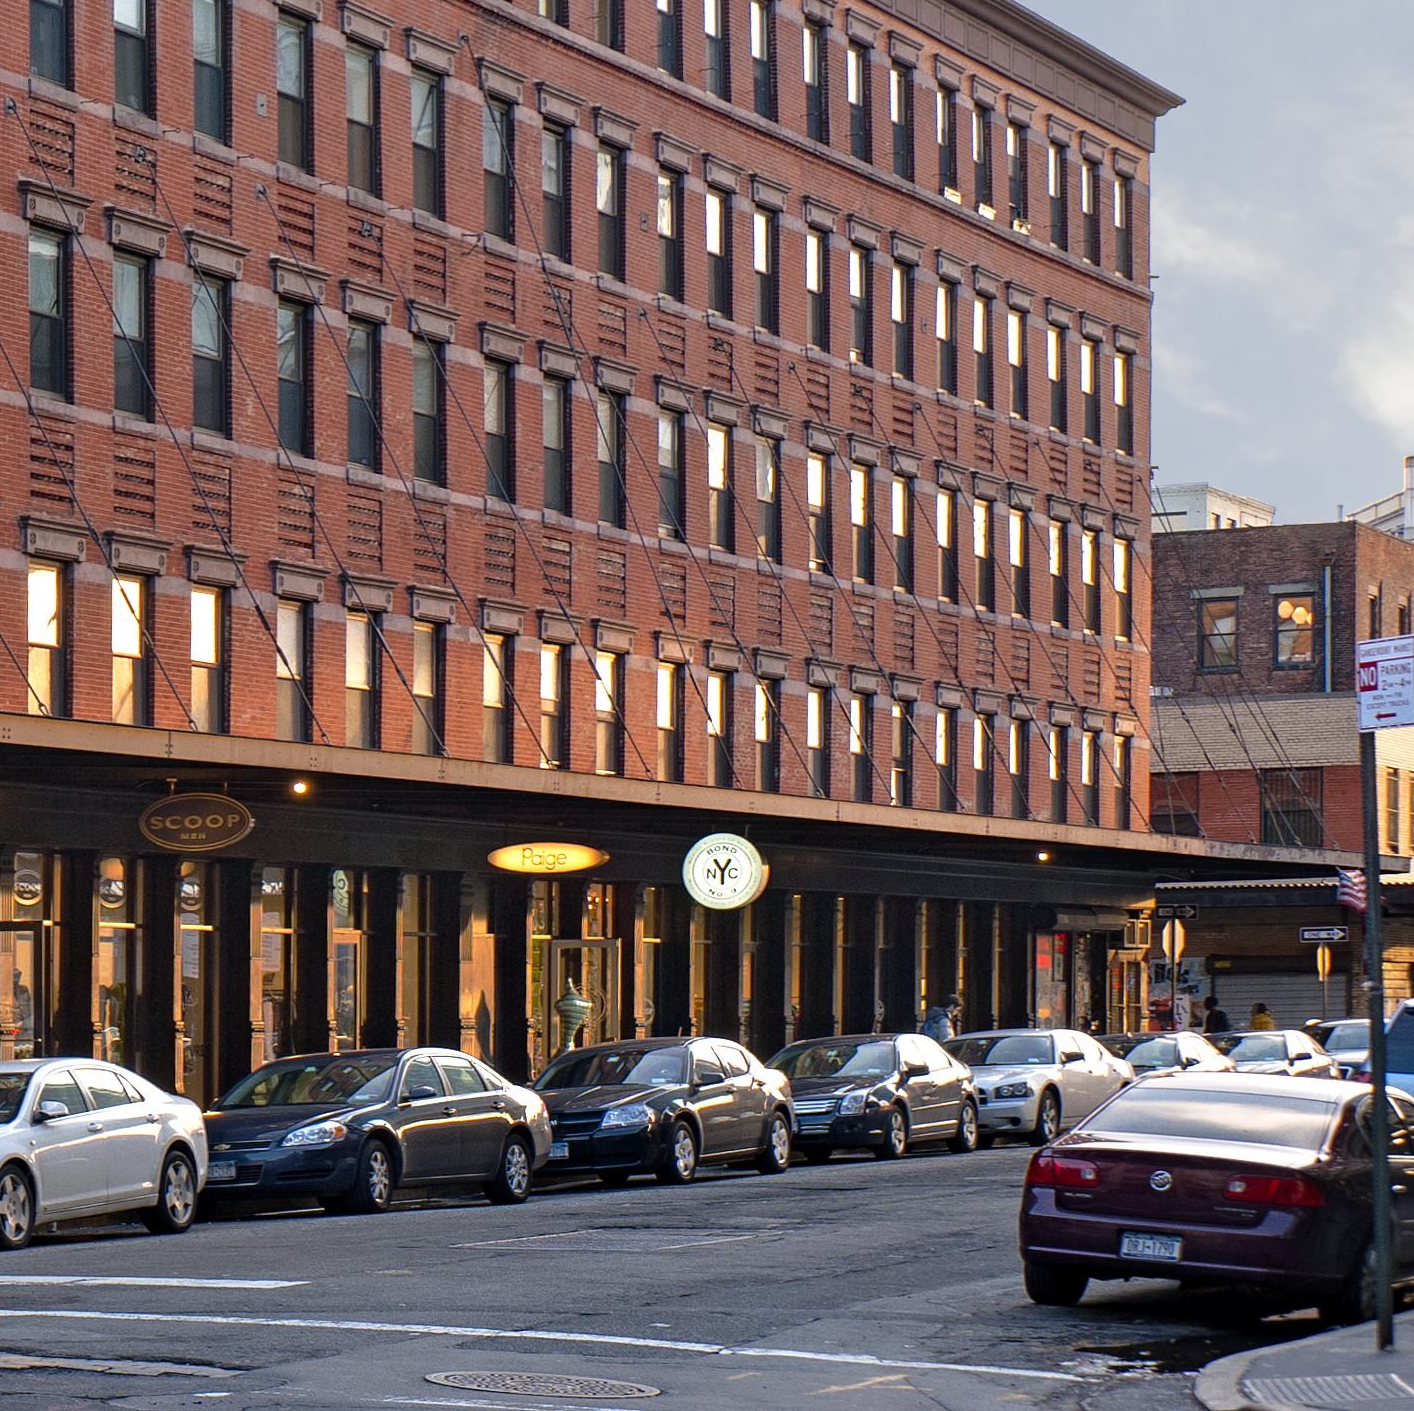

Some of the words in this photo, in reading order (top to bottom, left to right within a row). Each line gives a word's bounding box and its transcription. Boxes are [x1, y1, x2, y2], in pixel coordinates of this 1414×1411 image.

[1360, 667, 1376, 687] NO
[150, 814, 240, 829] SCOOP
[522, 848, 567, 870] Paige
[706, 845, 737, 855] BOND
[706, 858, 739, 885] NYC
